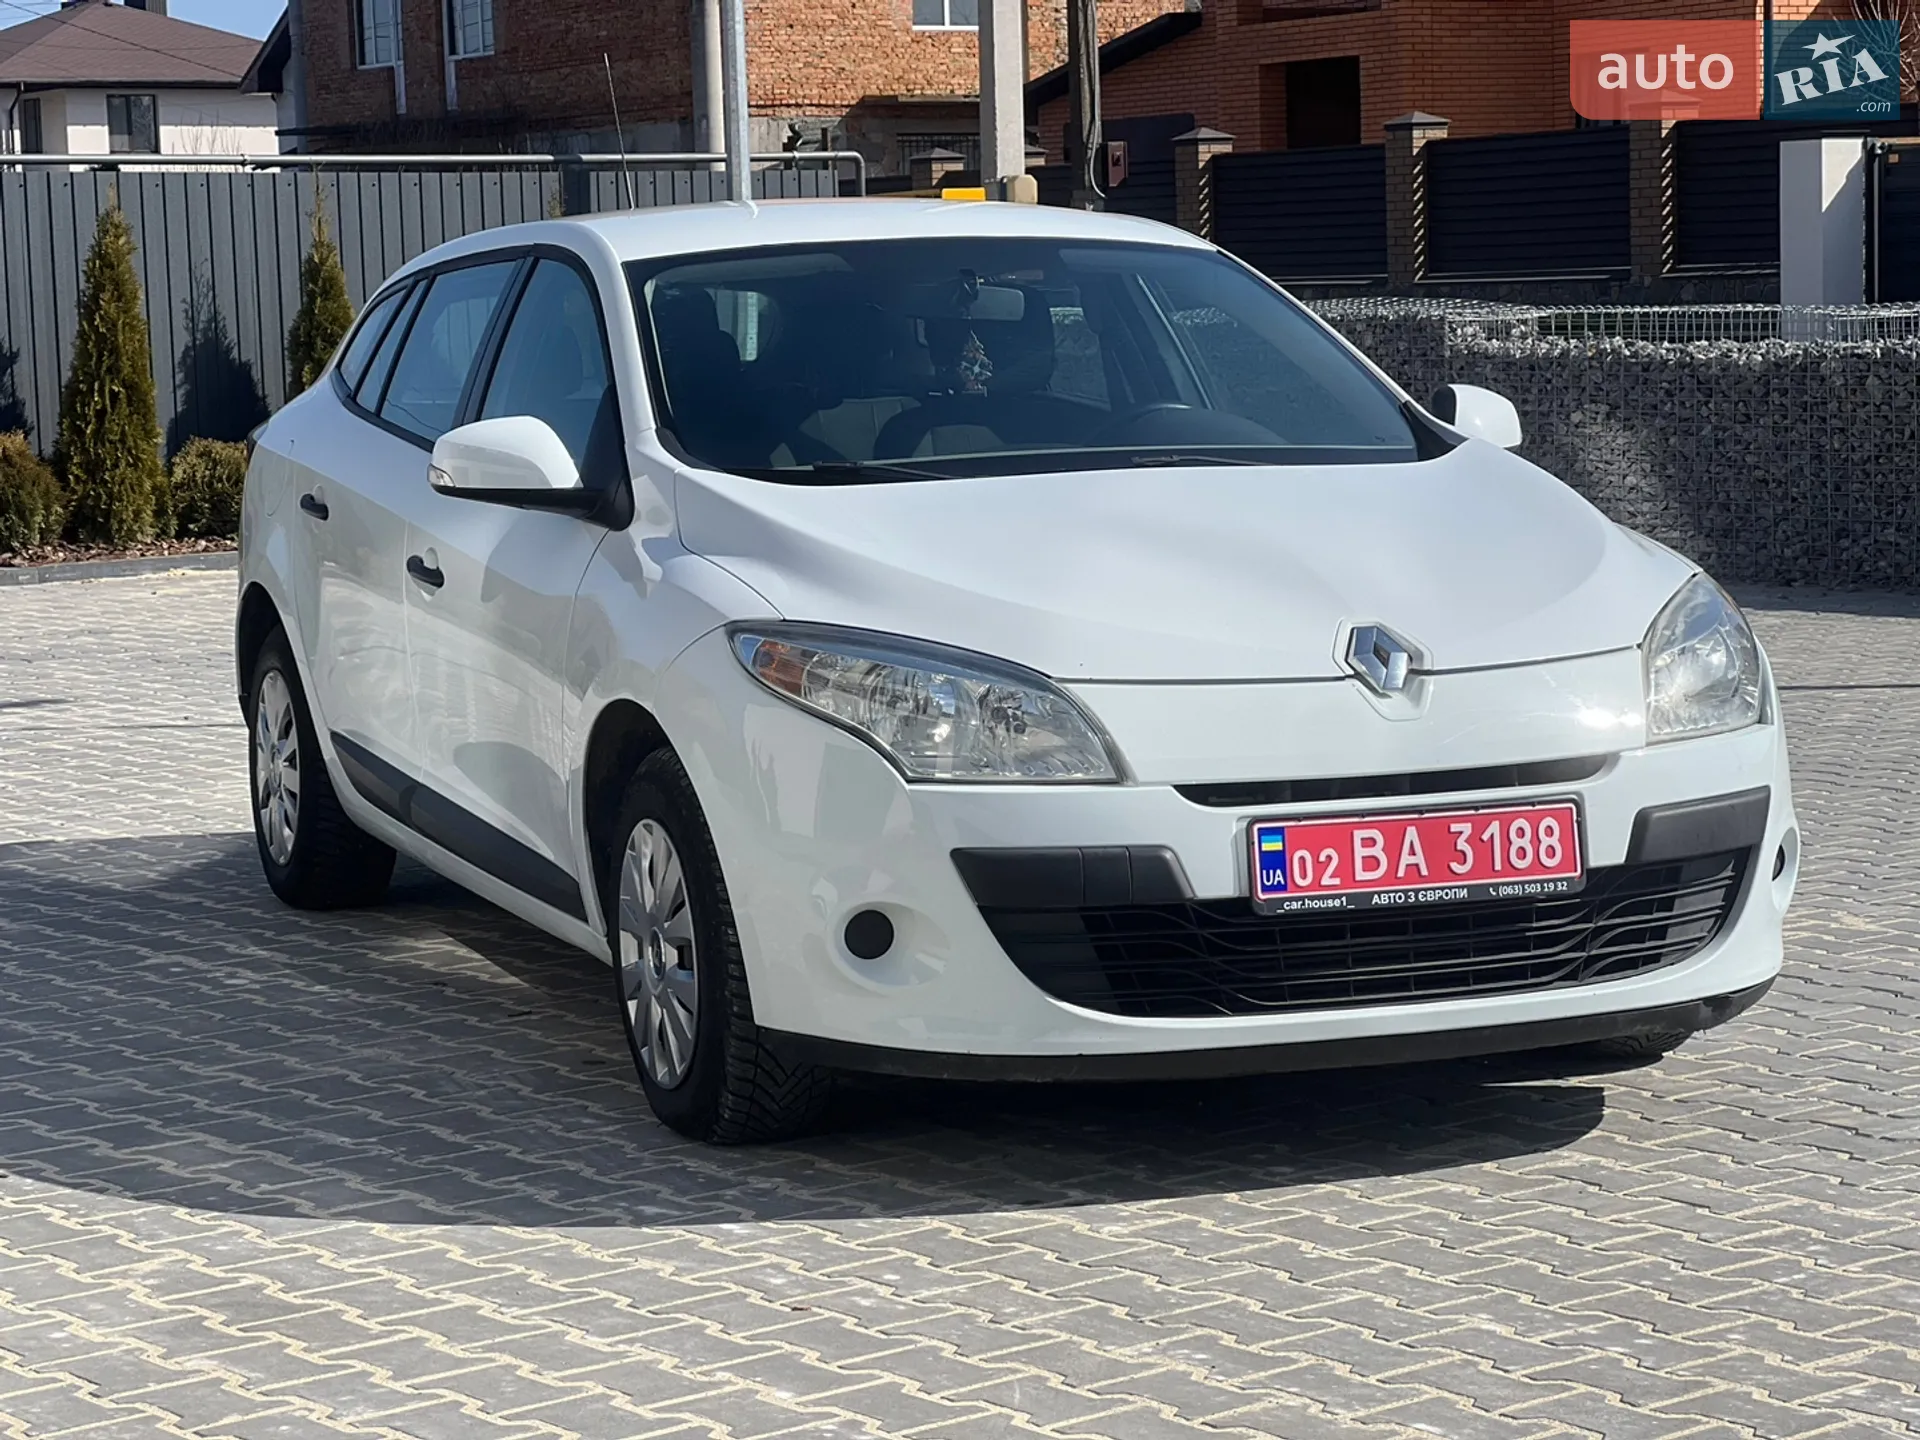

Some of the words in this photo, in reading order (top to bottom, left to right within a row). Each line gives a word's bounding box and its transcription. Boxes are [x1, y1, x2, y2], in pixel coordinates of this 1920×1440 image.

[1292, 847, 1341, 888] 02
[1449, 816, 1562, 875] 3188
[1262, 868, 1285, 886] UA
[1371, 892, 1405, 905] АВТО
[1418, 888, 1468, 901] ЄВРОПИ
[1498, 885, 1523, 896] (063)
[1524, 883, 1542, 893] 503
[1543, 882, 1555, 892] 19
[1556, 881, 1568, 891] 32
[1276, 896, 1355, 913] _car.house1_
